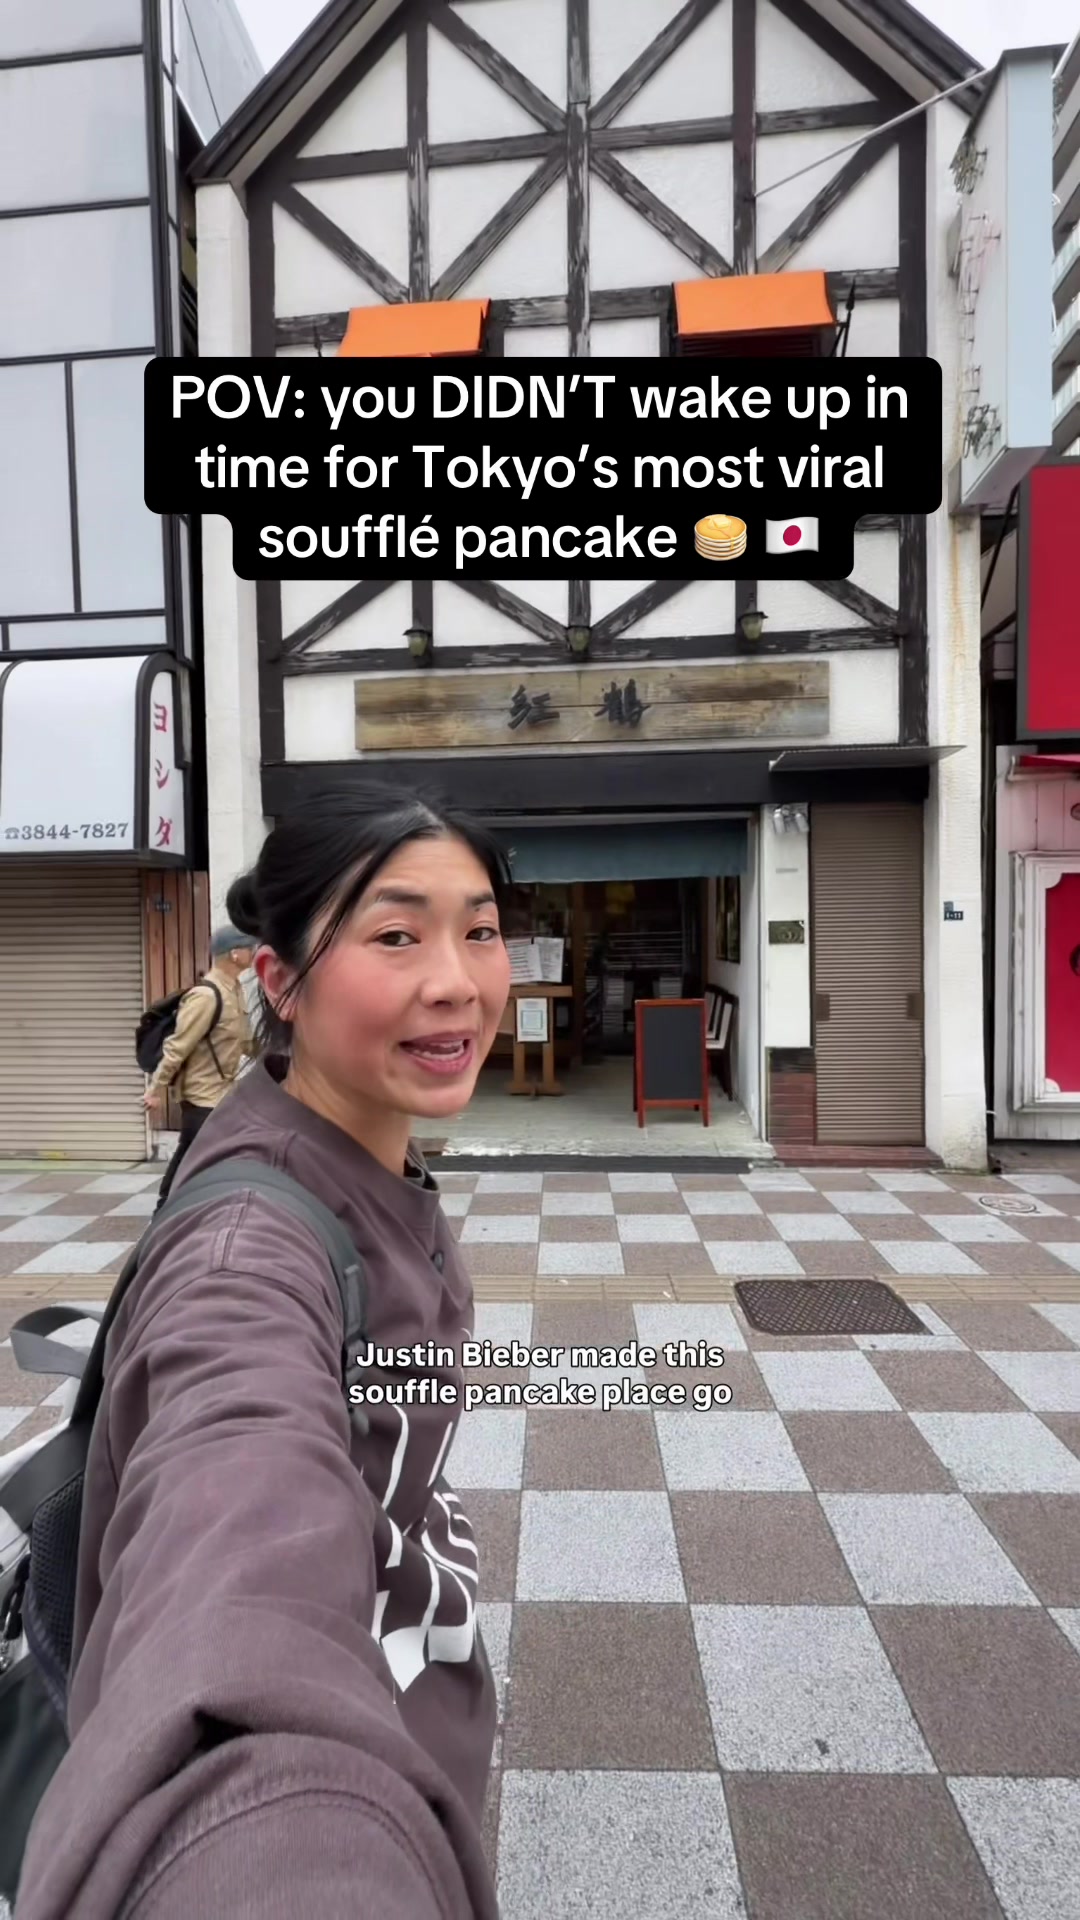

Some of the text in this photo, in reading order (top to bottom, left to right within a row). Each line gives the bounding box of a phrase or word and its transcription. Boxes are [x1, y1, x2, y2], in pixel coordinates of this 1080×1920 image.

[153, 702, 173, 847] ヨシダ
[22, 822, 129, 841] 3844-7827
